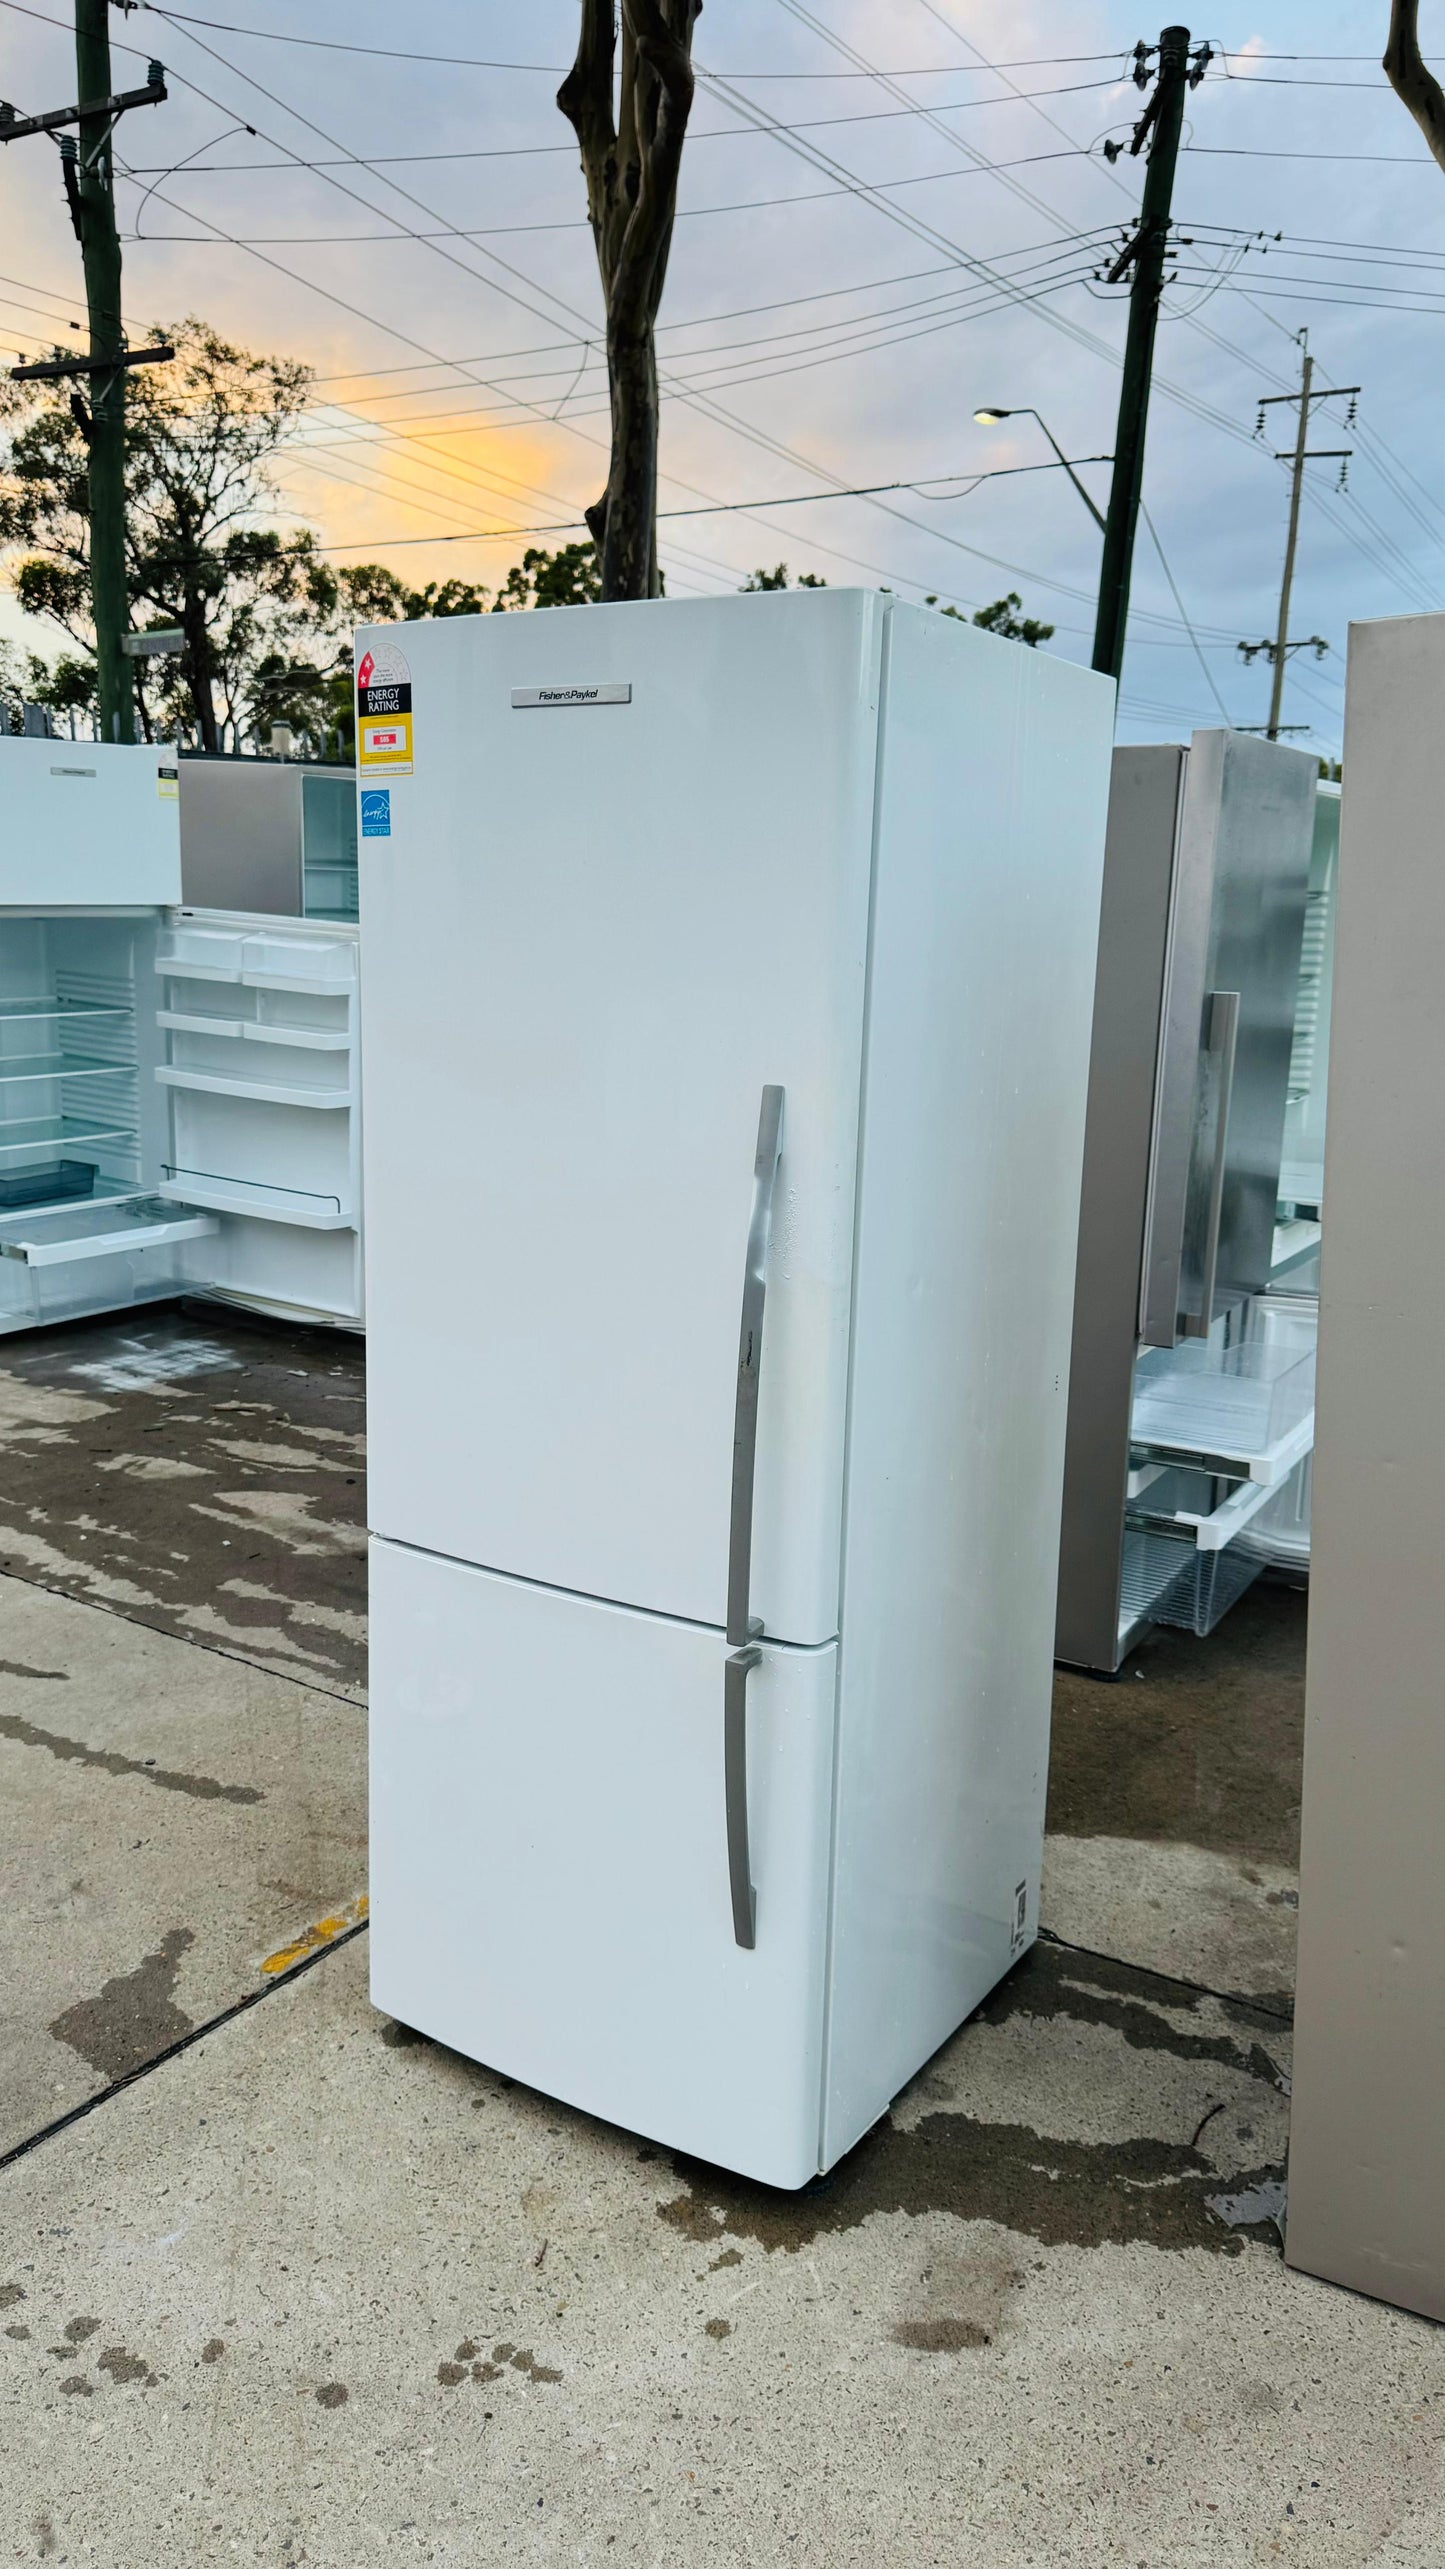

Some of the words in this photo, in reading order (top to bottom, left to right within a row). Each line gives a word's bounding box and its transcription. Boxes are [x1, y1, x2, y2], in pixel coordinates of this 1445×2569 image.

[367, 688, 399, 701] ENERGY
[539, 689, 598, 700] Fisher&Paykel
[368, 700, 399, 712] RATING
